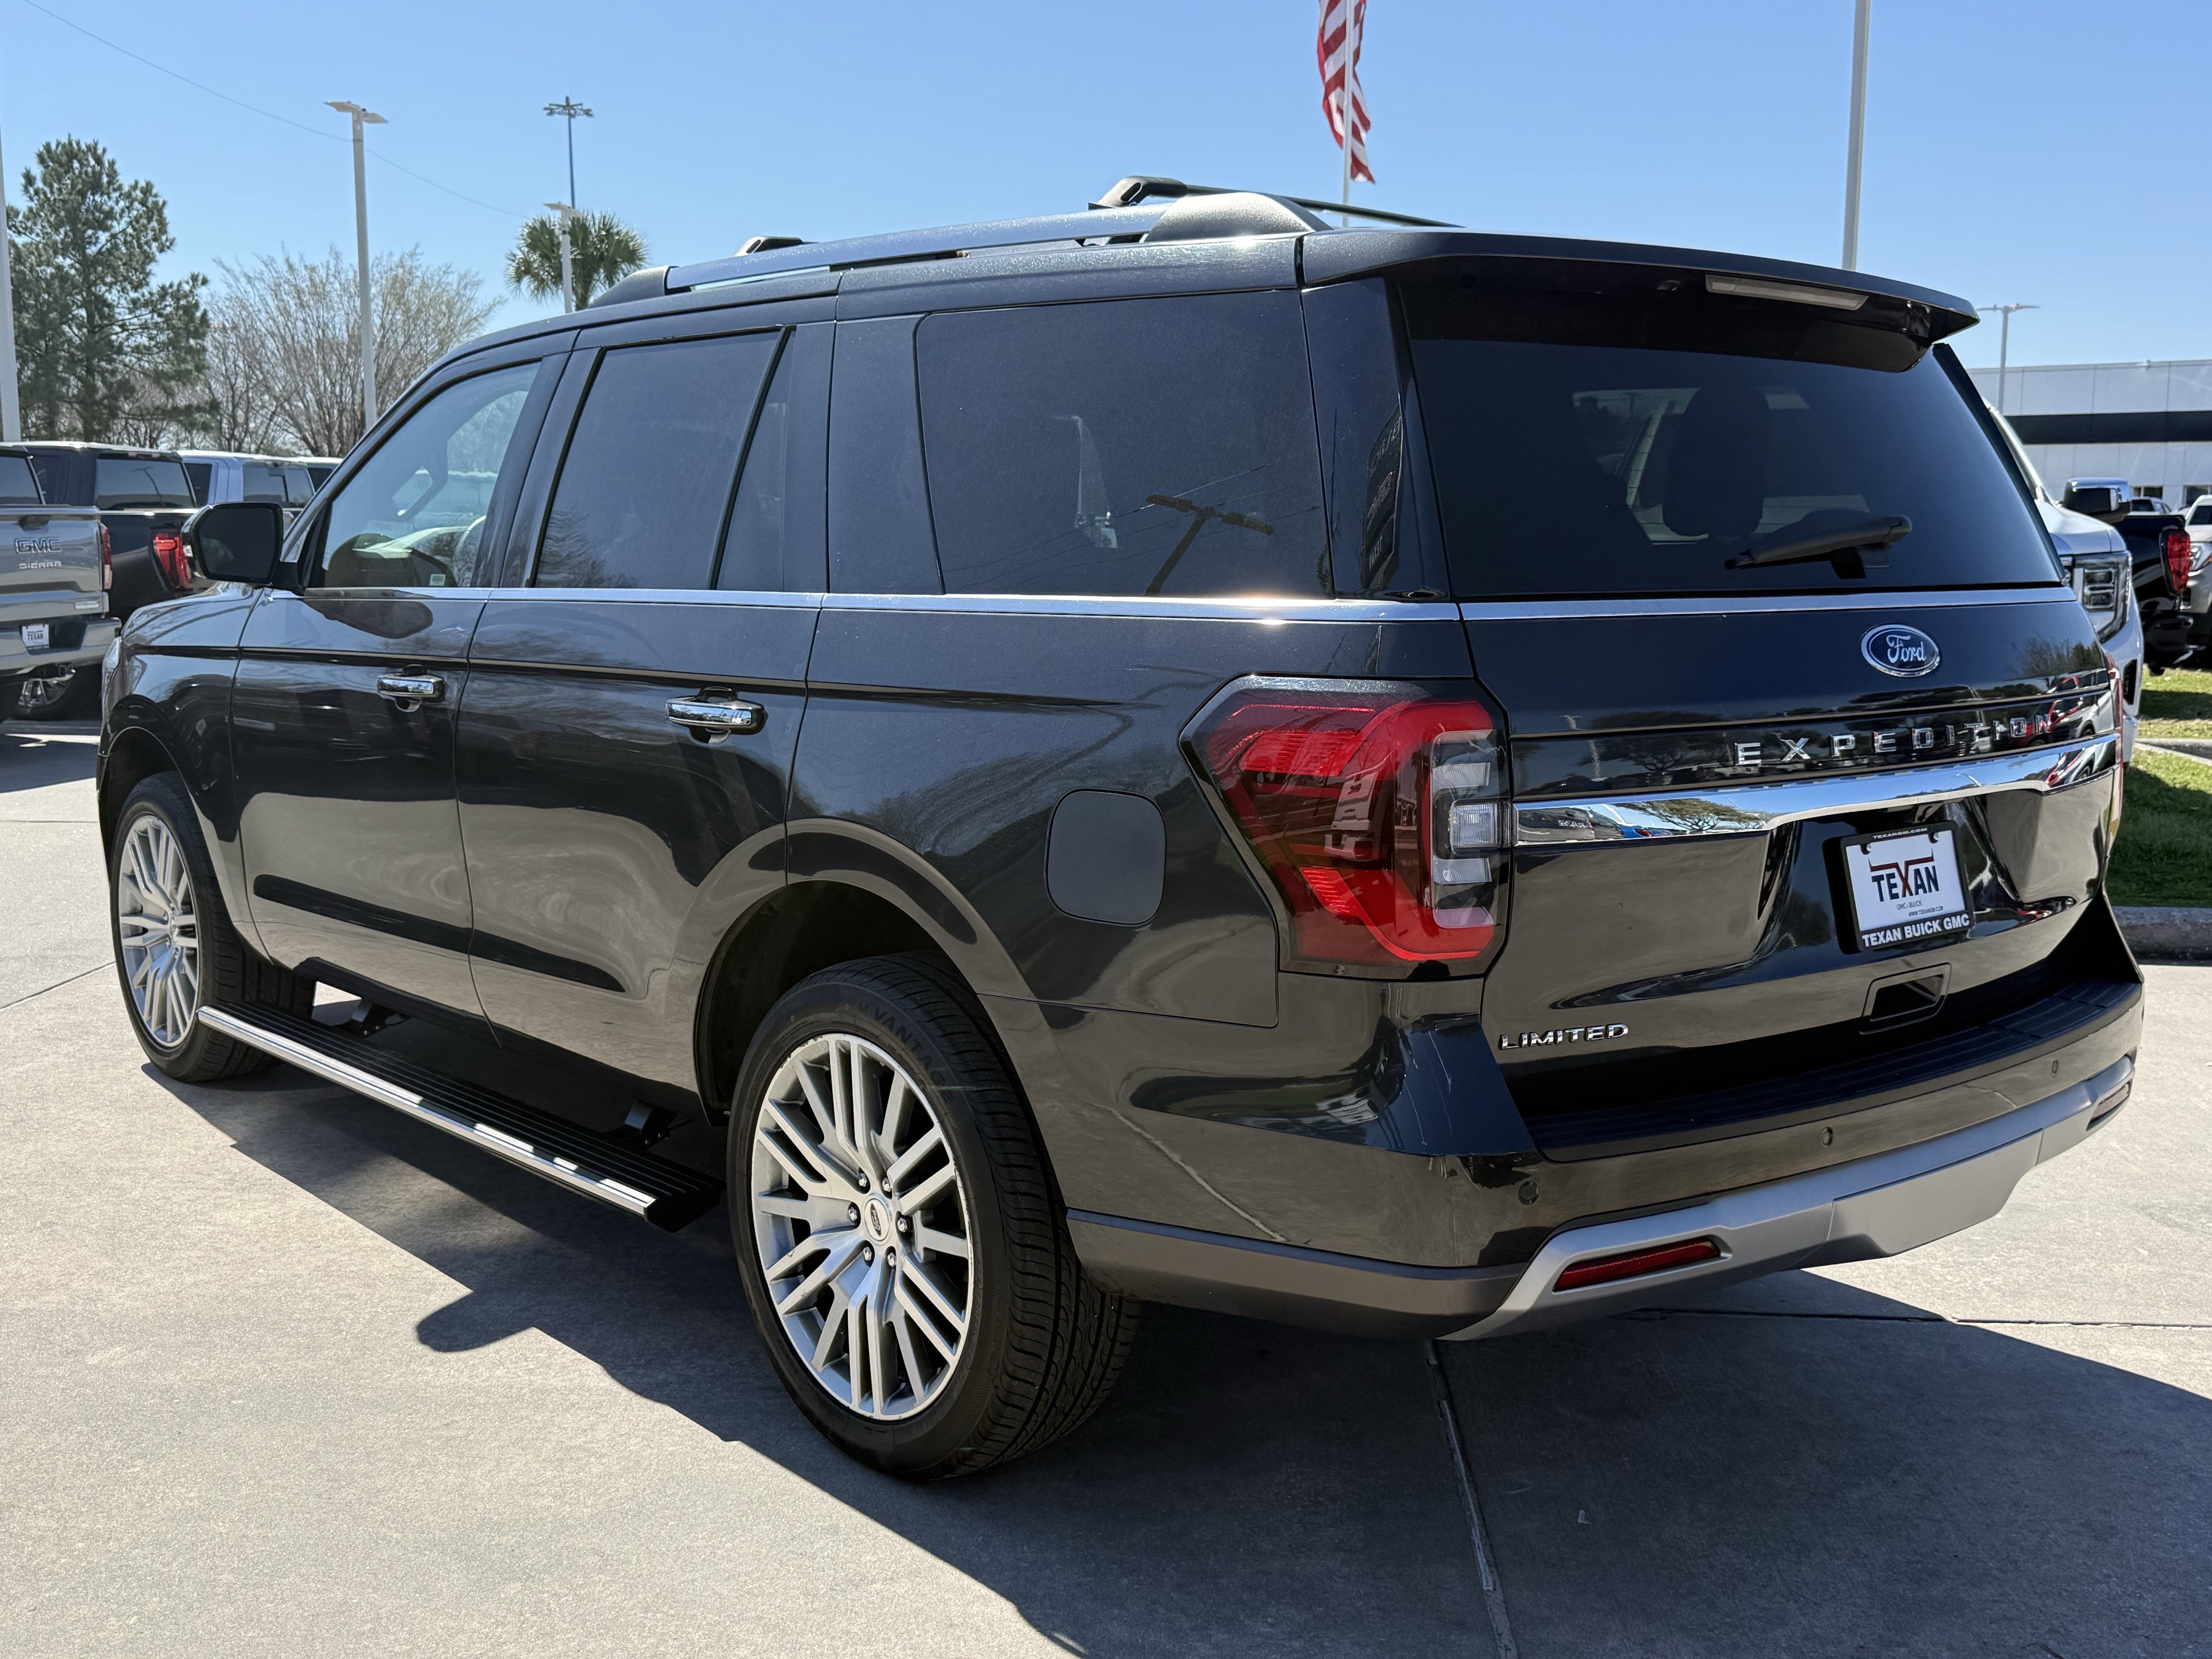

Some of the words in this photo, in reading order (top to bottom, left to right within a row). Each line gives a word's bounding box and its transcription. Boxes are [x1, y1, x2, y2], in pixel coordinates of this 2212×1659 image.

[15, 538, 62, 553] GMC
[19, 561, 62, 569] SIERRA
[1886, 634, 1926, 663] Ford
[1733, 713, 2052, 766] EXPEDITION
[1870, 857, 1939, 902] TEXAN
[1862, 928, 1902, 947] TEXAN
[1904, 919, 1942, 939] BUICK
[1943, 914, 1970, 930] GMC
[1499, 1023, 1628, 1050] LIMITED
